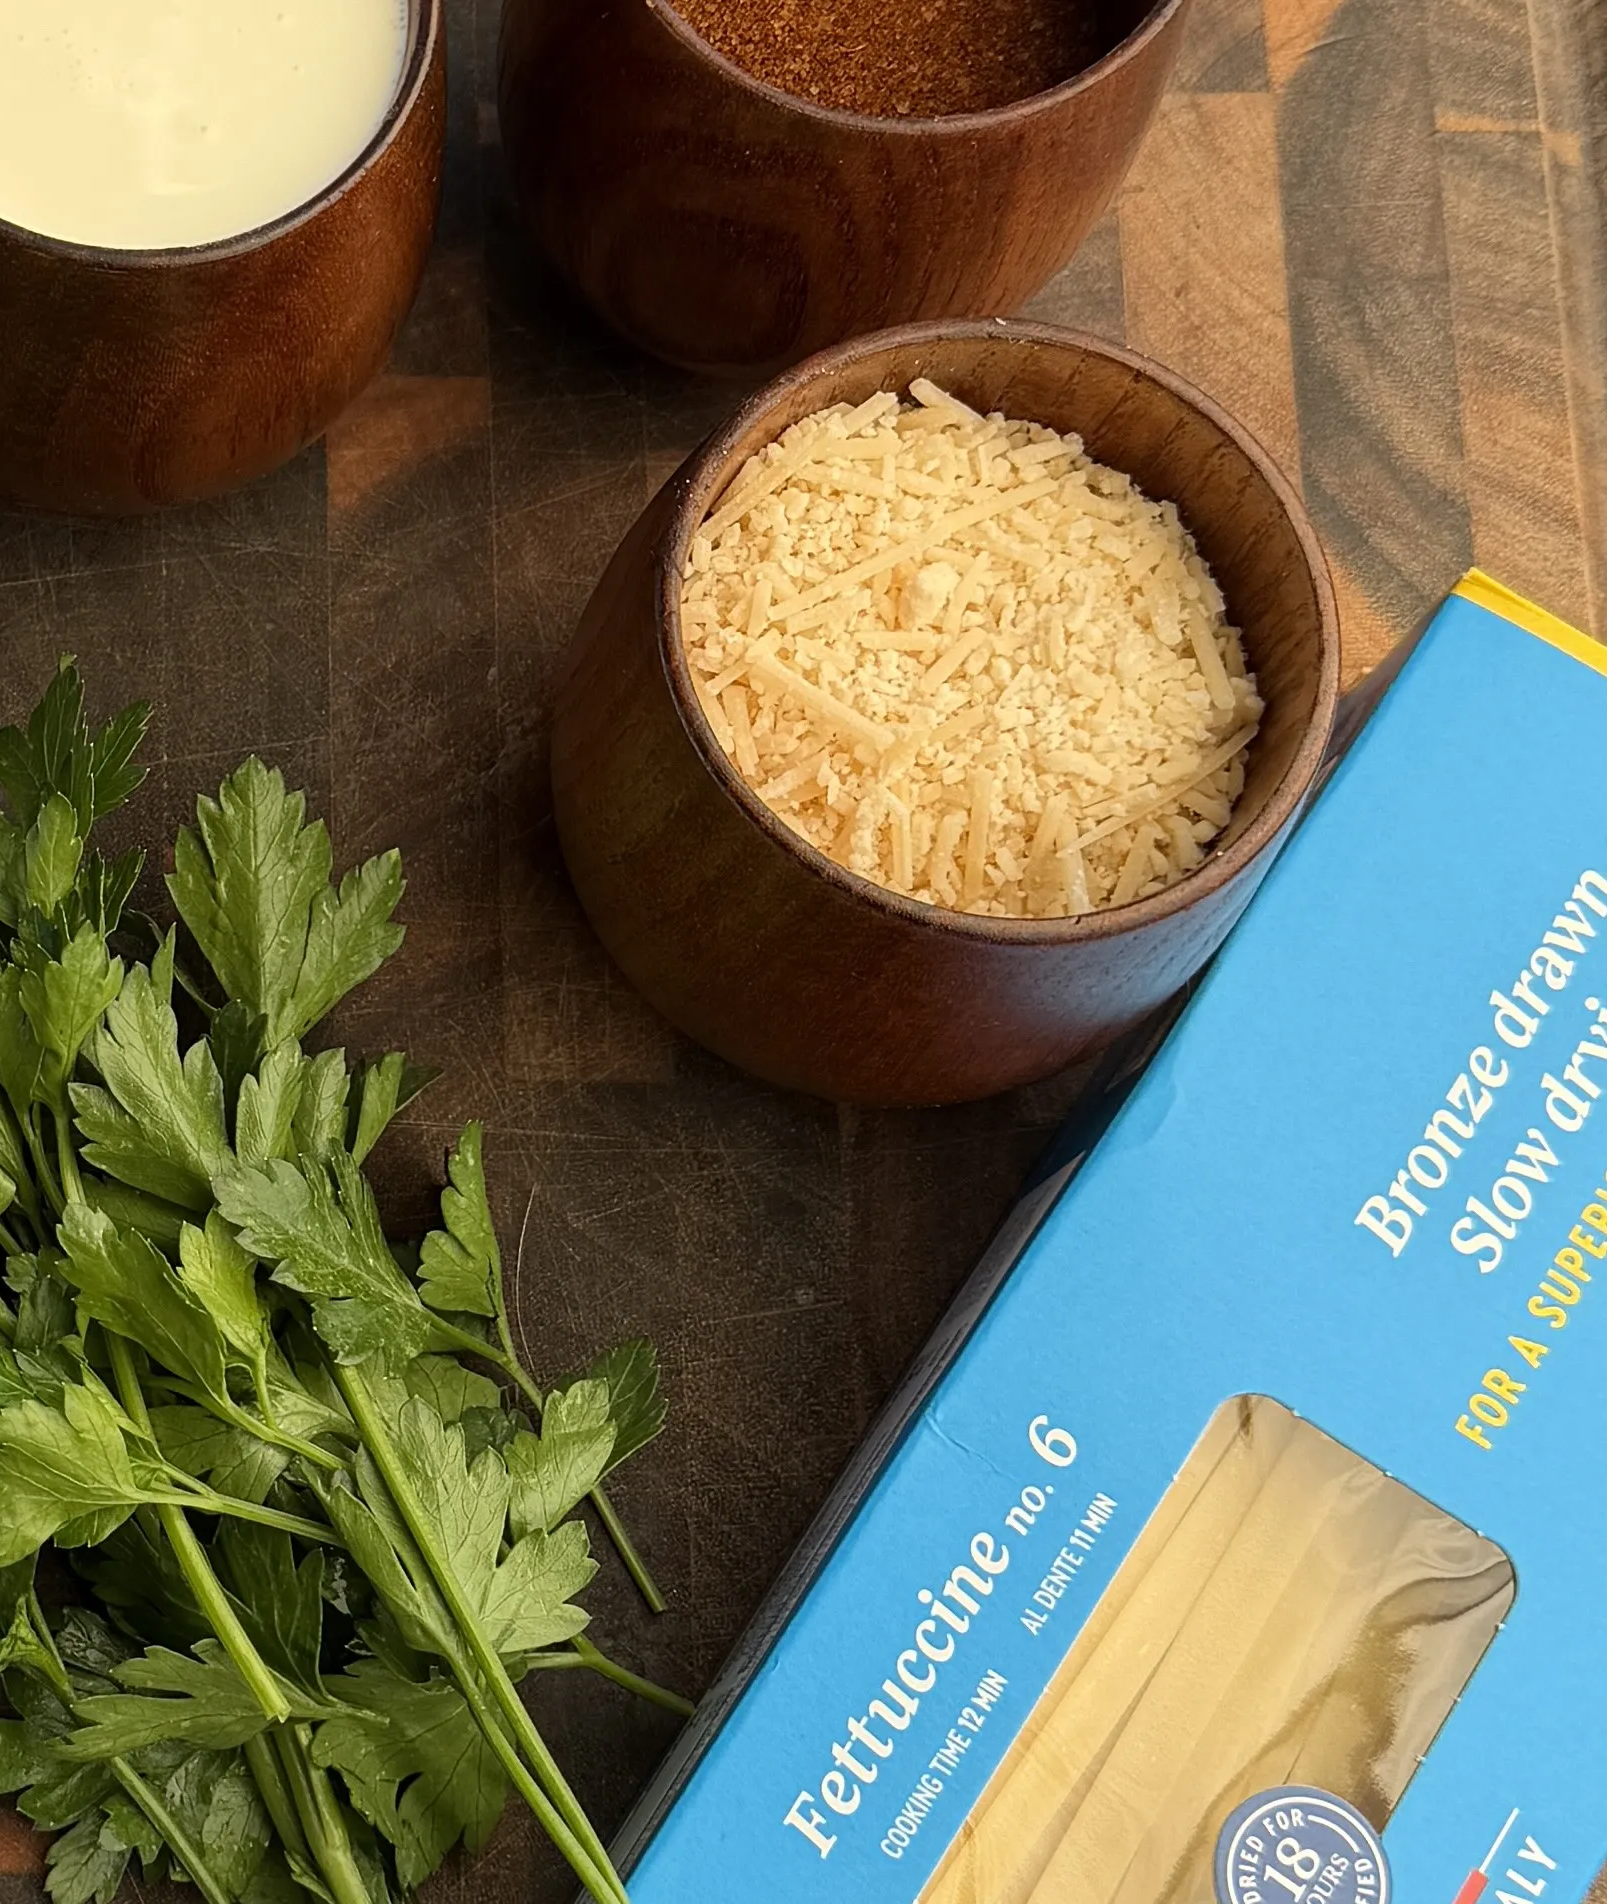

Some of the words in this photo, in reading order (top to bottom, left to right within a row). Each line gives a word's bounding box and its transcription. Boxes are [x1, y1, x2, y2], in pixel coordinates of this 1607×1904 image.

[1354, 1043, 1509, 1258] Bronze
[1489, 867, 1607, 1049] drawn
[1450, 1127, 1562, 1274] Slow
[1454, 1366, 1527, 1451] FOR
[1507, 1334, 1550, 1370] A
[1027, 1412, 1079, 1468] 6
[1004, 1483, 1055, 1537] no.
[1080, 1491, 1118, 1535] MIN
[1069, 1528, 1096, 1552] 11
[1033, 1546, 1084, 1610] DENTE
[1020, 1607, 1049, 1637] AL
[782, 1530, 1011, 1860] Fettuccine
[971, 1668, 1010, 1713] MIN
[957, 1705, 986, 1733] 12
[929, 1727, 972, 1777] TIME
[879, 1773, 944, 1860] COOKING
[1262, 1808, 1305, 1837] FOR
[1263, 1837, 1322, 1904] 18
